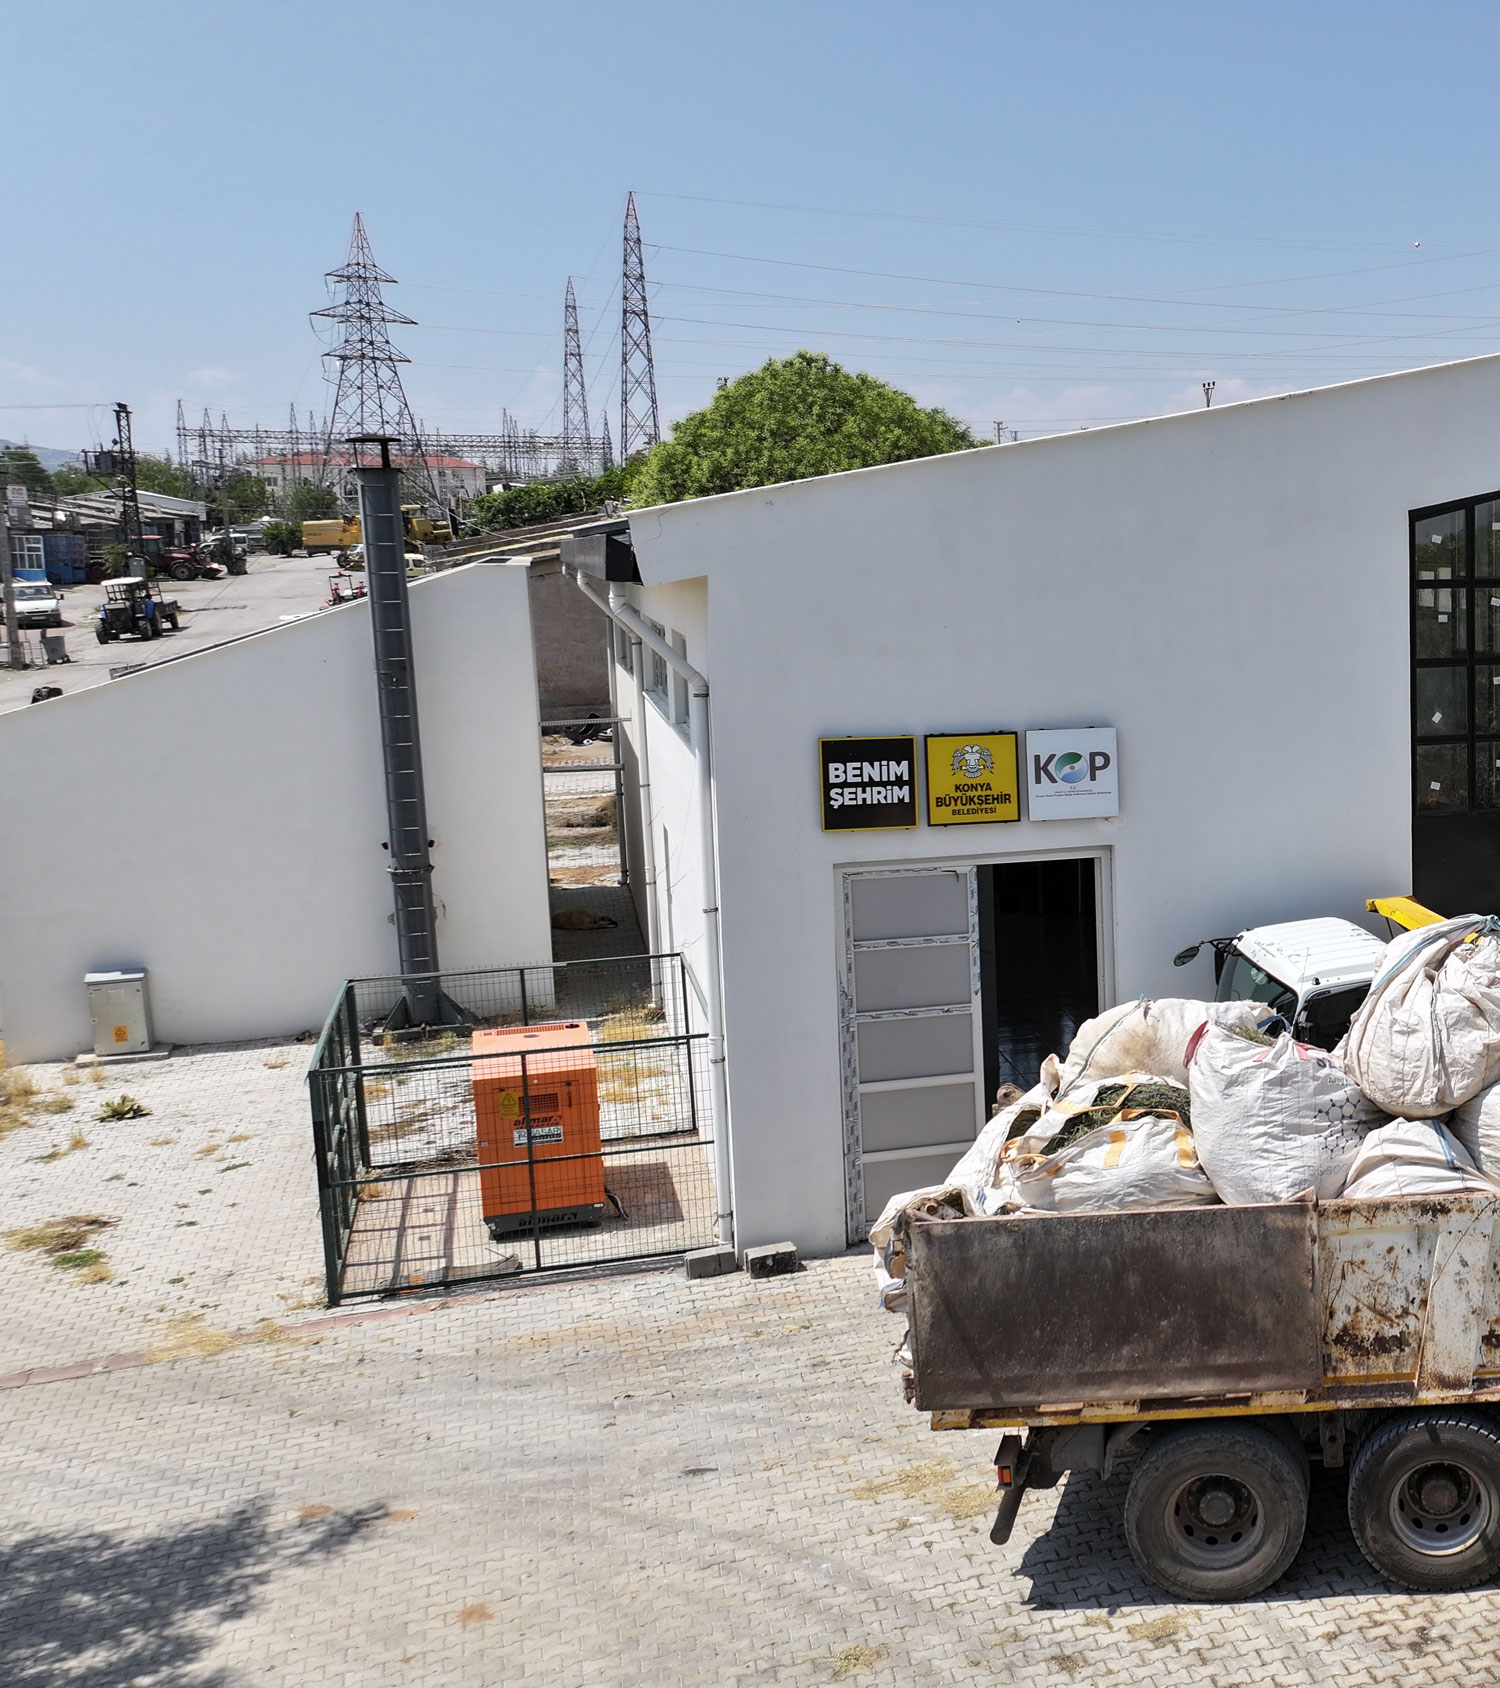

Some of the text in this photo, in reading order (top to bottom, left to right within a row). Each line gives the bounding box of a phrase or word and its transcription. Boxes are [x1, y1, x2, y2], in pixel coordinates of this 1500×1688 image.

[955, 782, 993, 793] KONYA
[935, 792, 1012, 808] BÜYÜKŞEHİR
[951, 806, 997, 816] BELEDİYESİ
